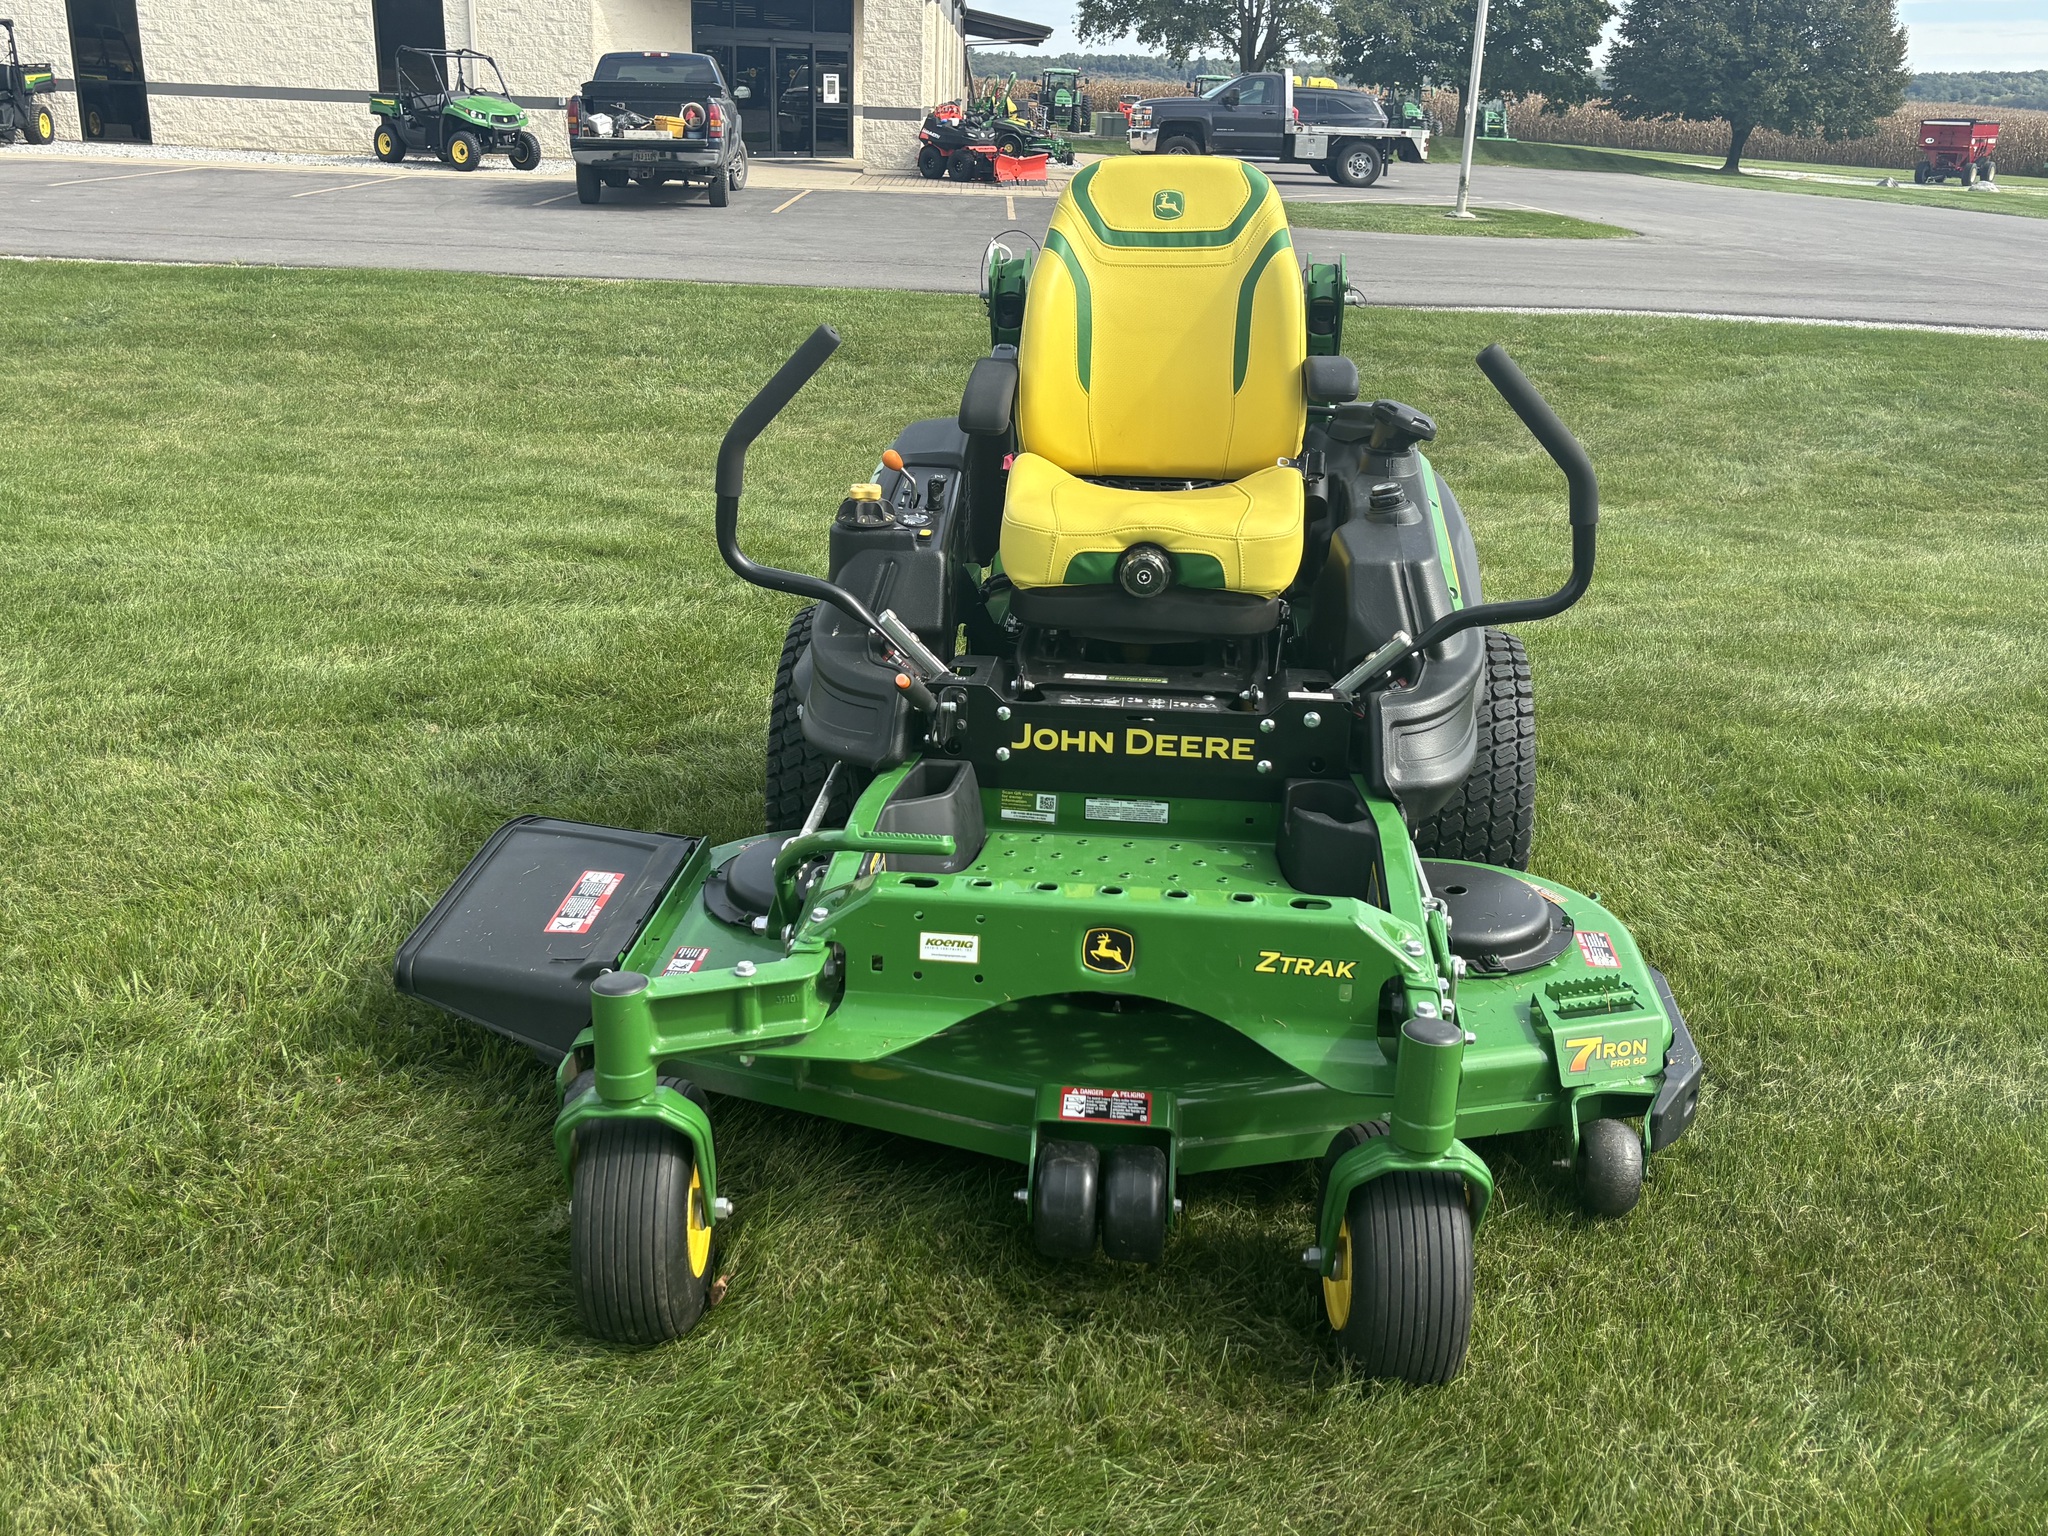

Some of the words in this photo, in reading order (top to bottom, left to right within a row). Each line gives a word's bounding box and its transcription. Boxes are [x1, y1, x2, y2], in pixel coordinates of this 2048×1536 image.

[1011, 723, 1113, 754] JOHN
[1126, 728, 1255, 760] DEERE
[1254, 950, 1357, 980] ZTRAK
[1610, 1057, 1631, 1069] PRO
[1633, 1056, 1648, 1067] 60
[1080, 1088, 1104, 1096] DANGER
[1120, 1091, 1145, 1099] PELIGRO
